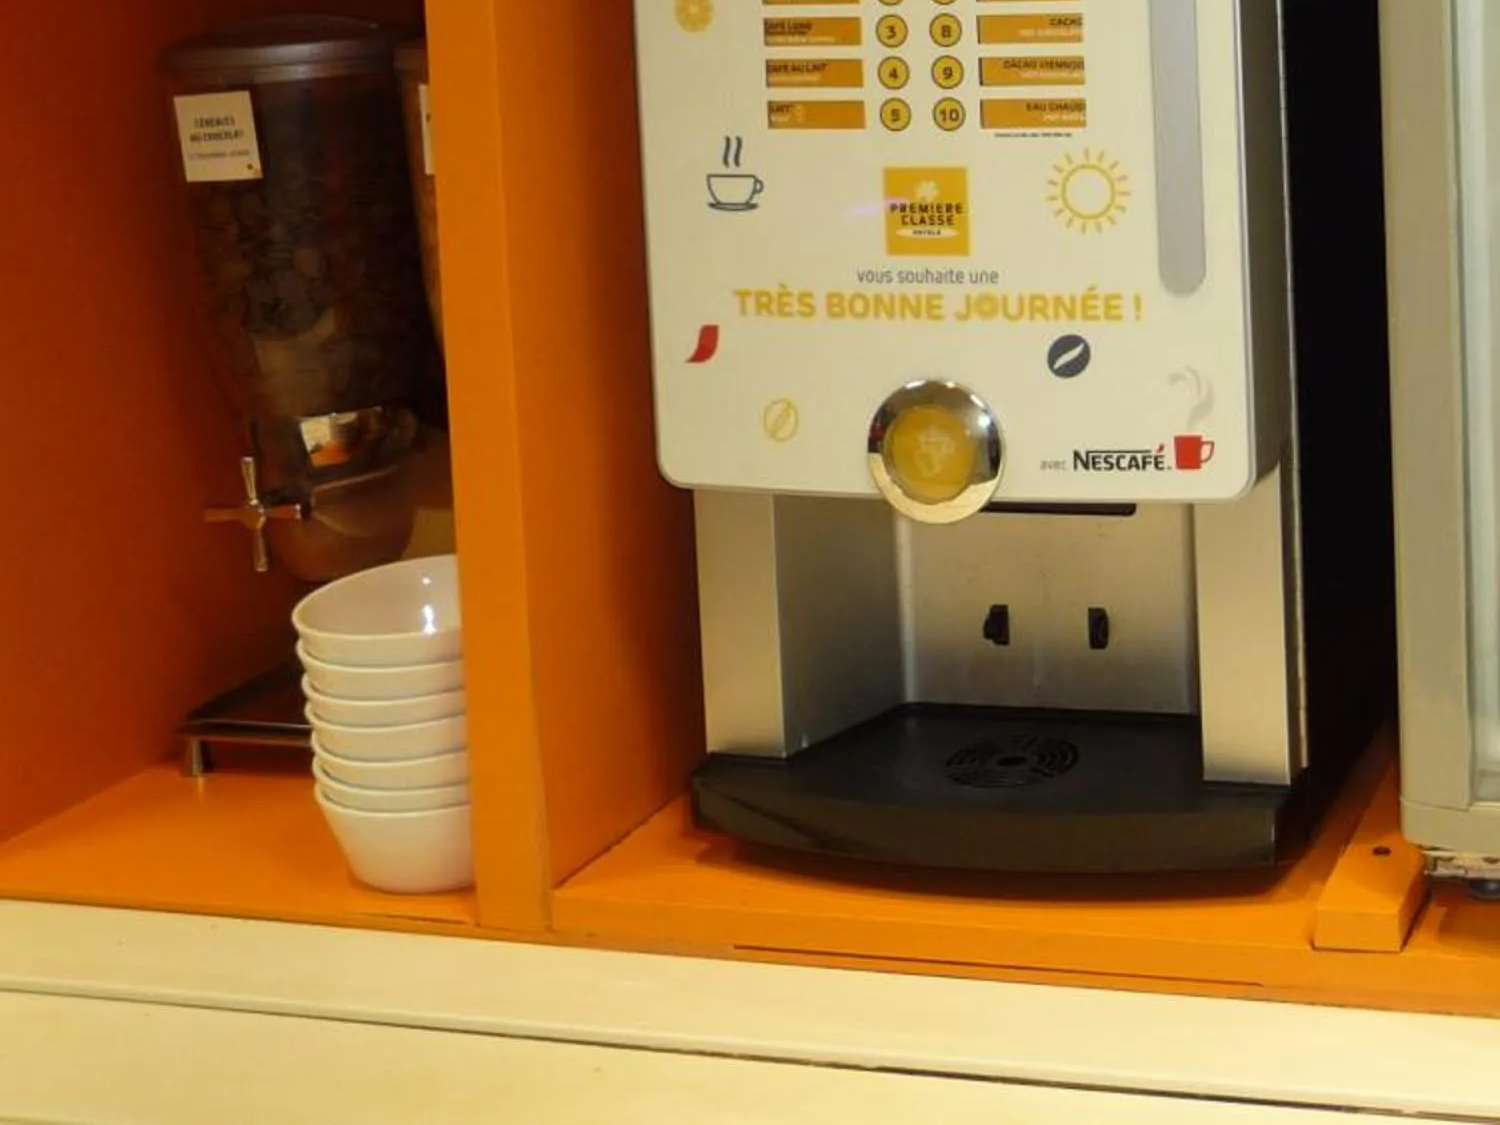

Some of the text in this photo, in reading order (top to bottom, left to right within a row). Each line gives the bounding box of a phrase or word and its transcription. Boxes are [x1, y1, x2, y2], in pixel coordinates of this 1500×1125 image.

[887, 25, 897, 39] 3
[941, 24, 952, 38] 8
[888, 67, 898, 80] 4
[943, 66, 953, 80] 9
[1048, 102, 1086, 112] CHAUD
[890, 108, 900, 122] 5
[940, 108, 960, 122] 10
[901, 214, 955, 226] CLASSE
[857, 267, 999, 285] vous souhaite une
[734, 284, 816, 318] TRÈS
[826, 291, 943, 321] BONNE
[954, 286, 1124, 322] JOURNÉE
[1040, 443, 1166, 472] avec NESCAFÉ
